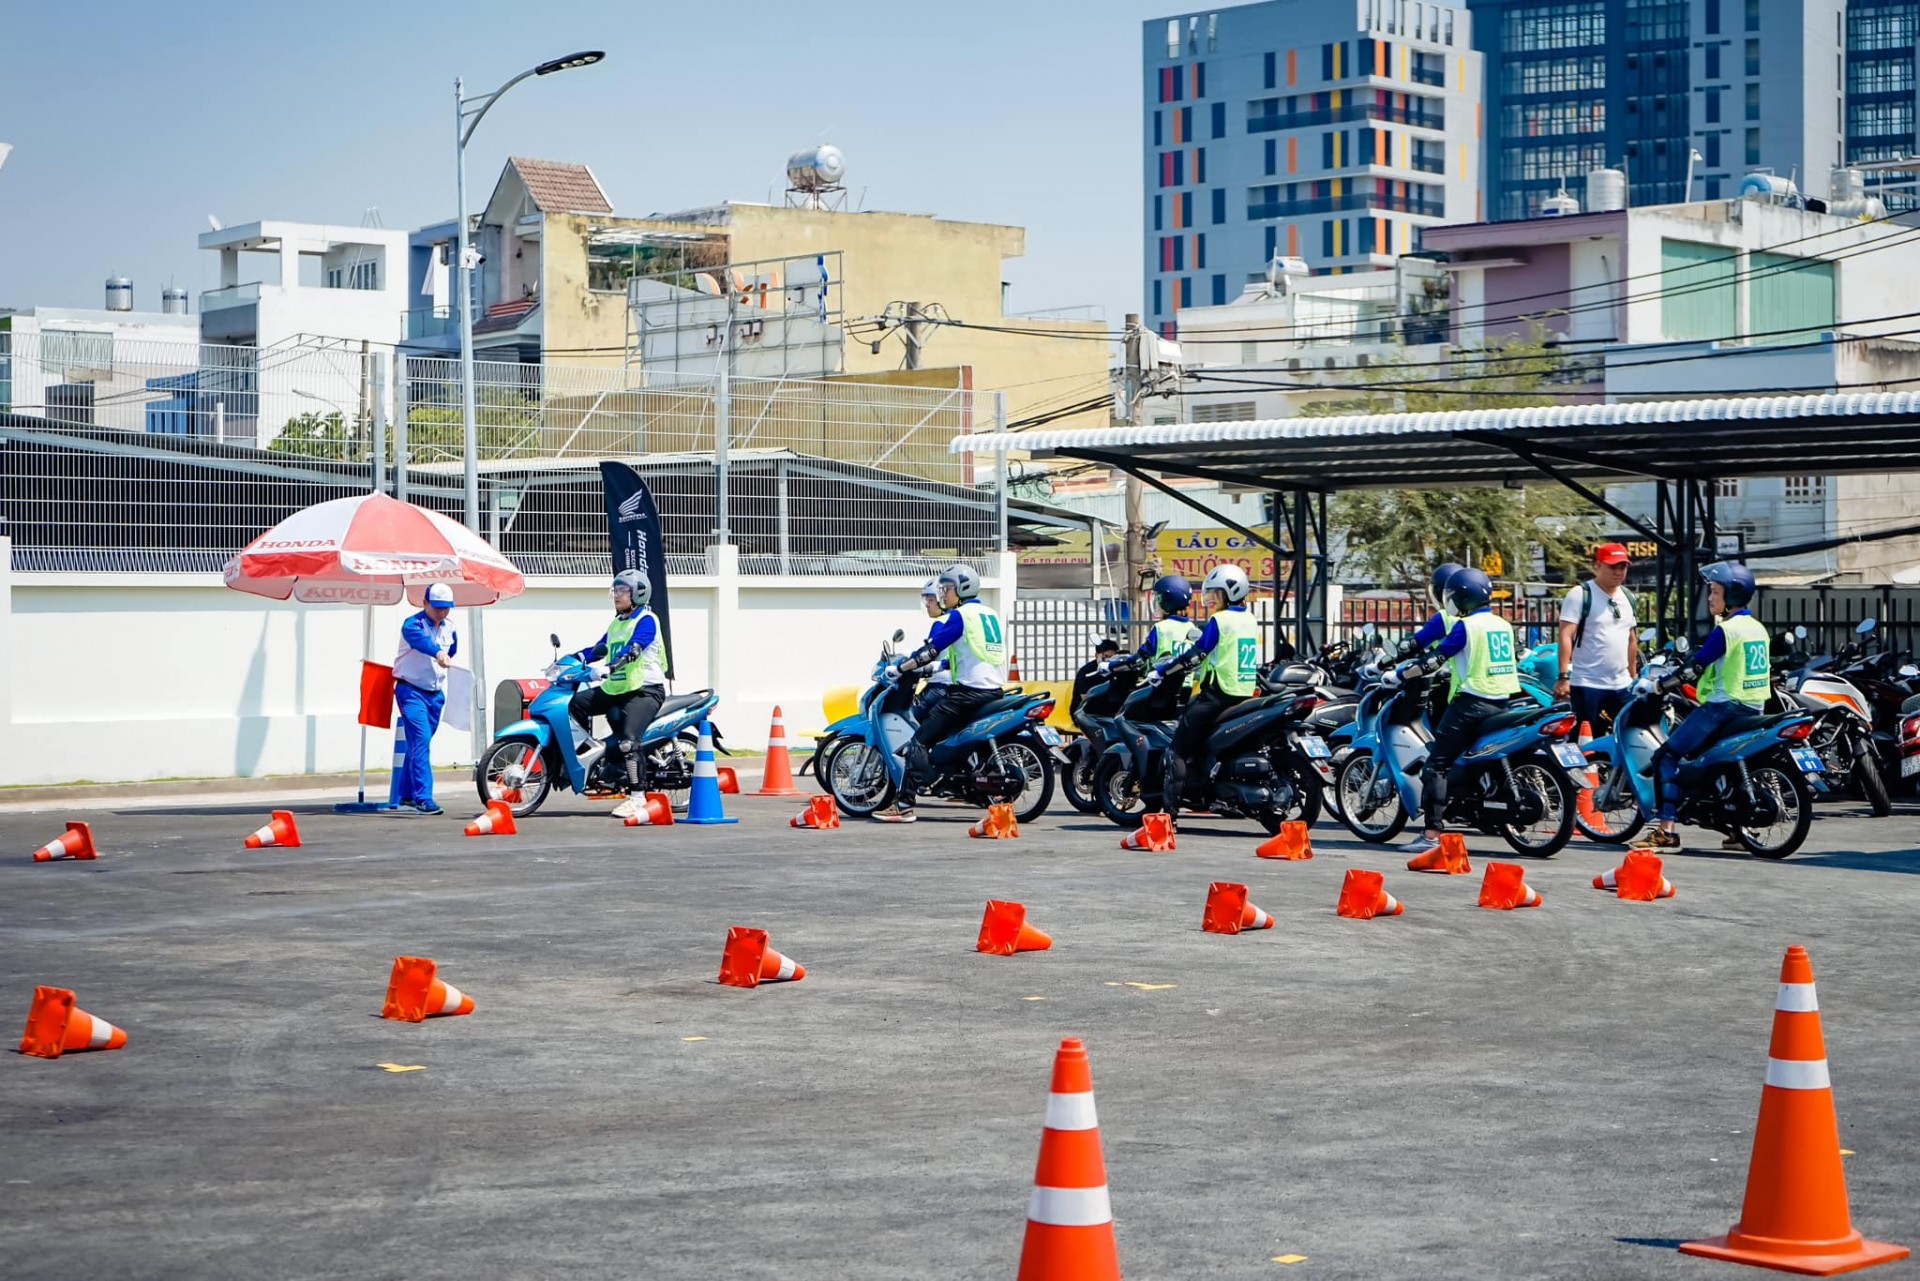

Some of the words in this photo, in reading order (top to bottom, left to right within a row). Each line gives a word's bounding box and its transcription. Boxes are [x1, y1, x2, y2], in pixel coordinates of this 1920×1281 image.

[258, 539, 336, 549] HONDA
[1627, 542, 1657, 556] FISH
[1241, 644, 1257, 669] 22
[1491, 633, 1511, 659] 95
[1750, 644, 1768, 670] 28
